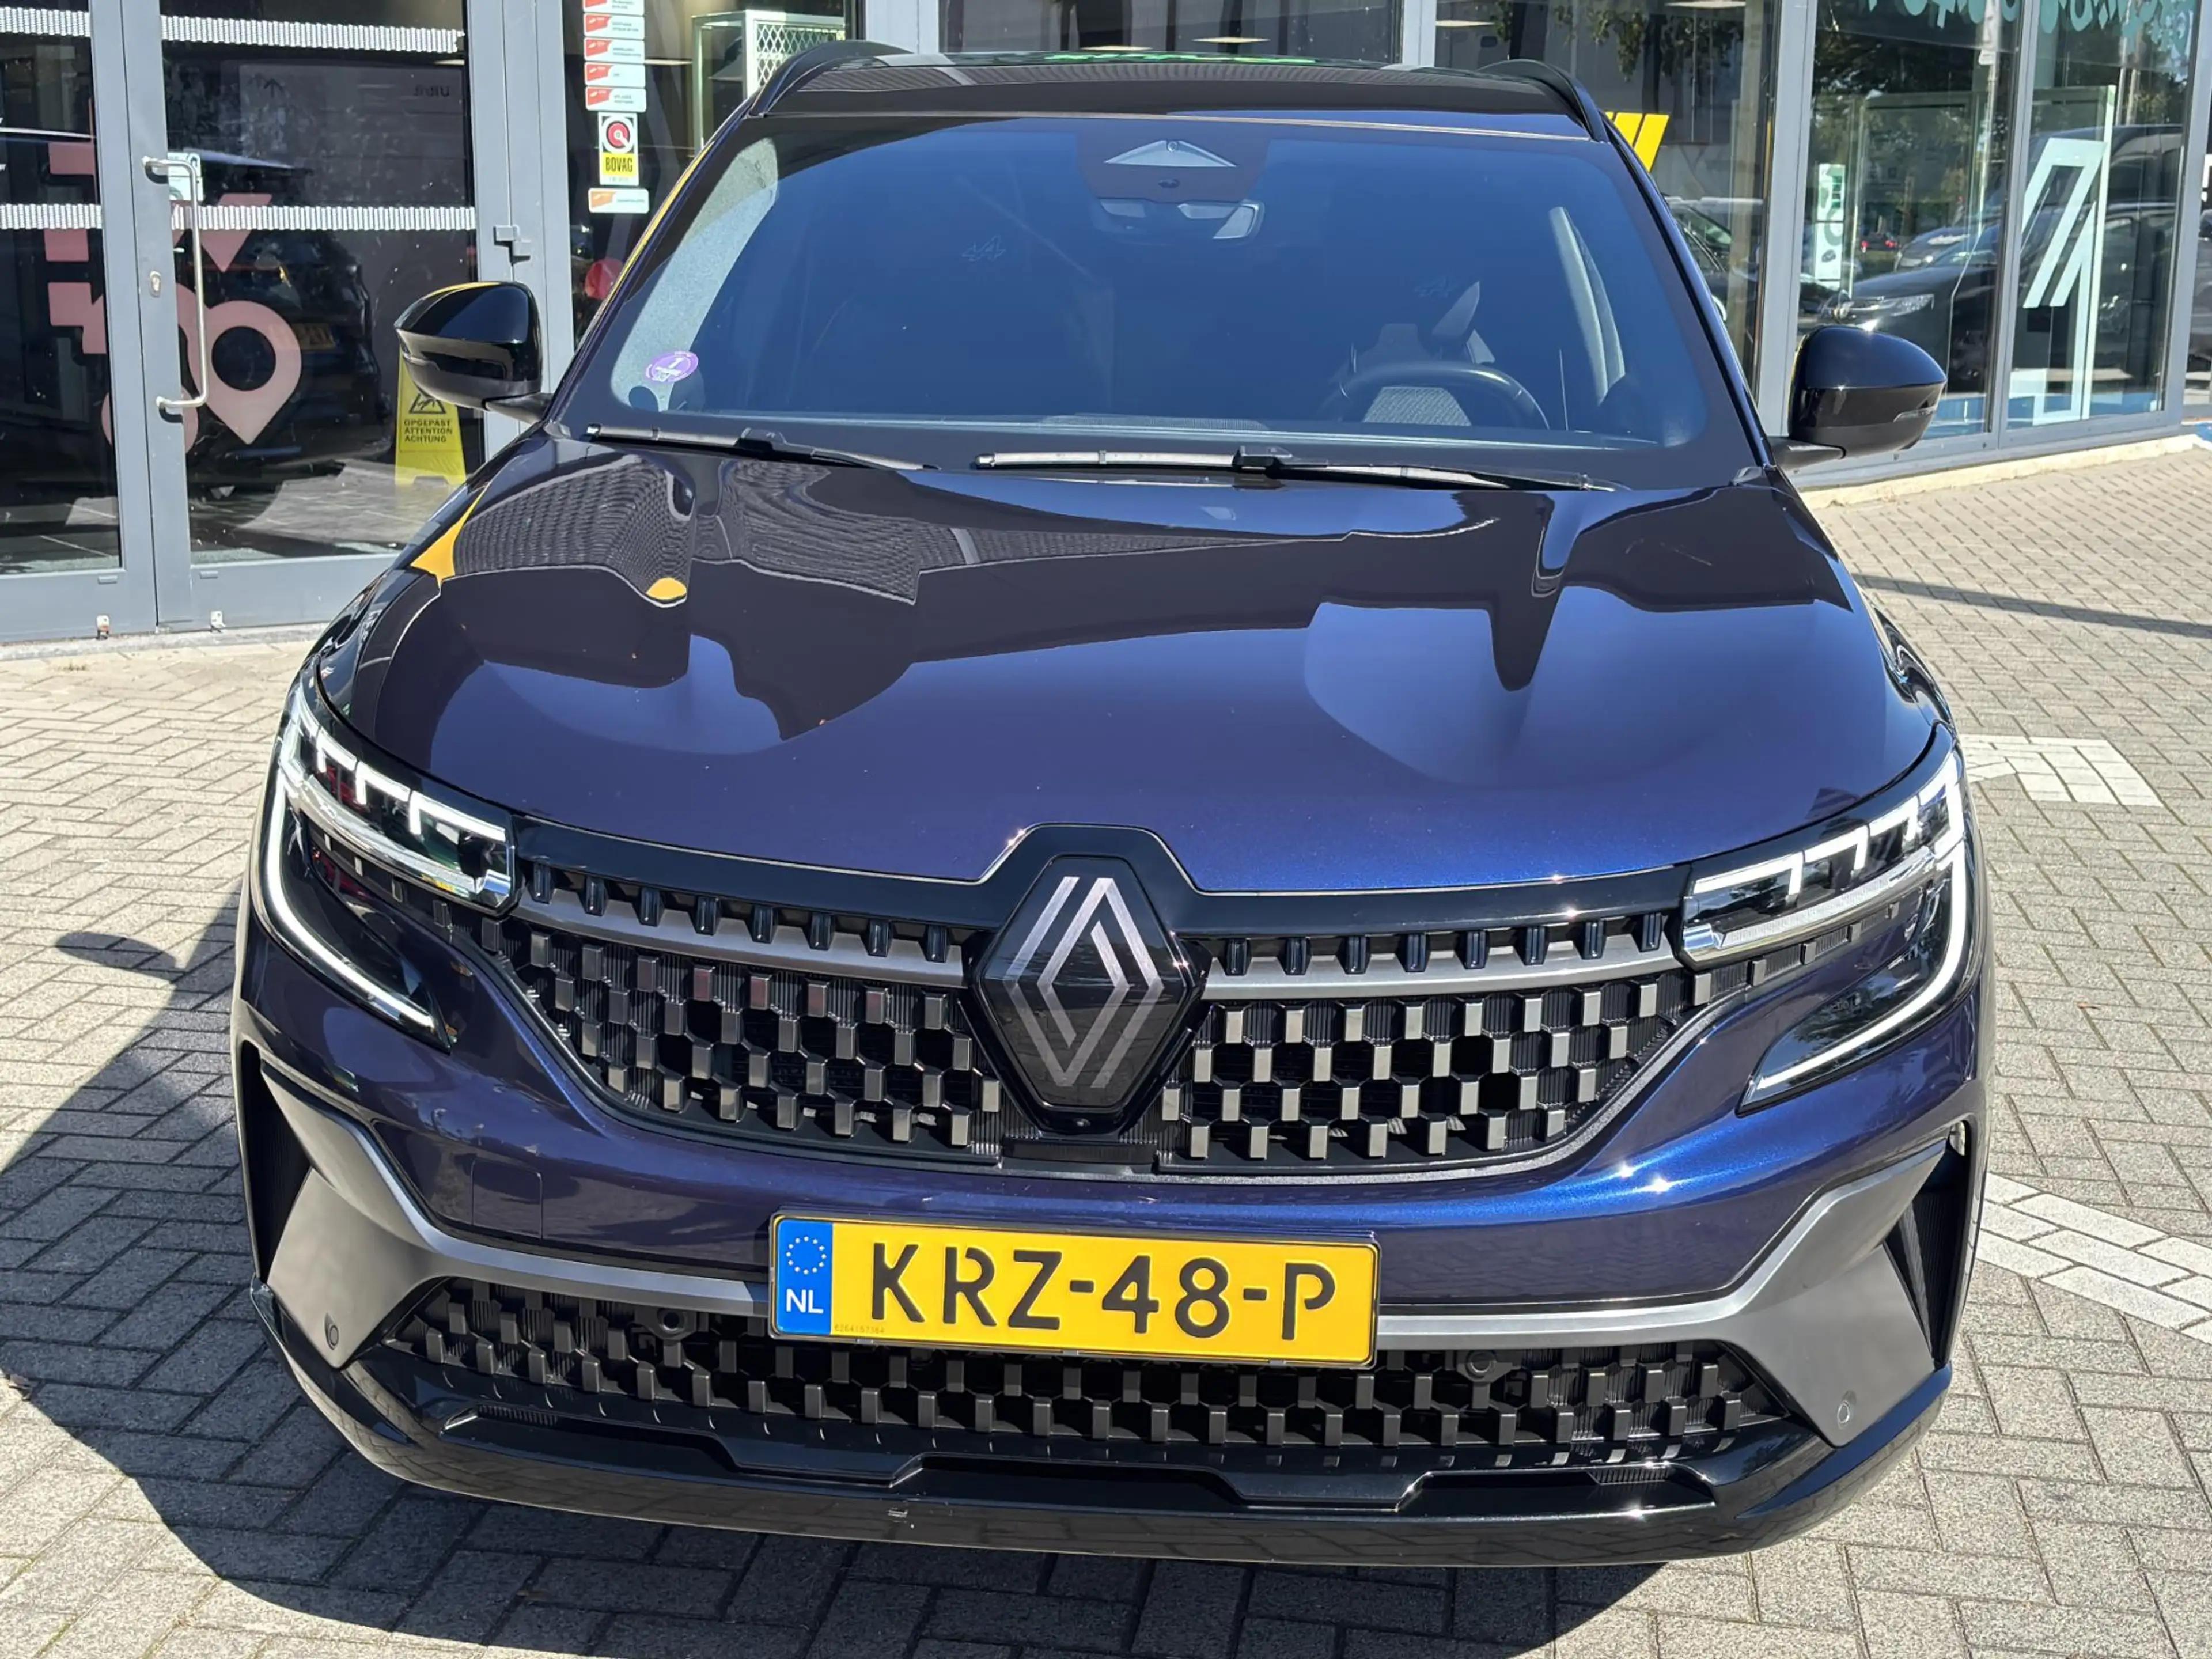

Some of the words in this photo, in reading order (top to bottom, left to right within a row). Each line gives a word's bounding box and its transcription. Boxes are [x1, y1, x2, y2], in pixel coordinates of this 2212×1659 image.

[605, 157, 633, 172] BOVAG
[404, 427, 453, 435] ATTENTION
[786, 1288, 824, 1314] NL
[872, 1242, 1336, 1340] KRZ-48-P
